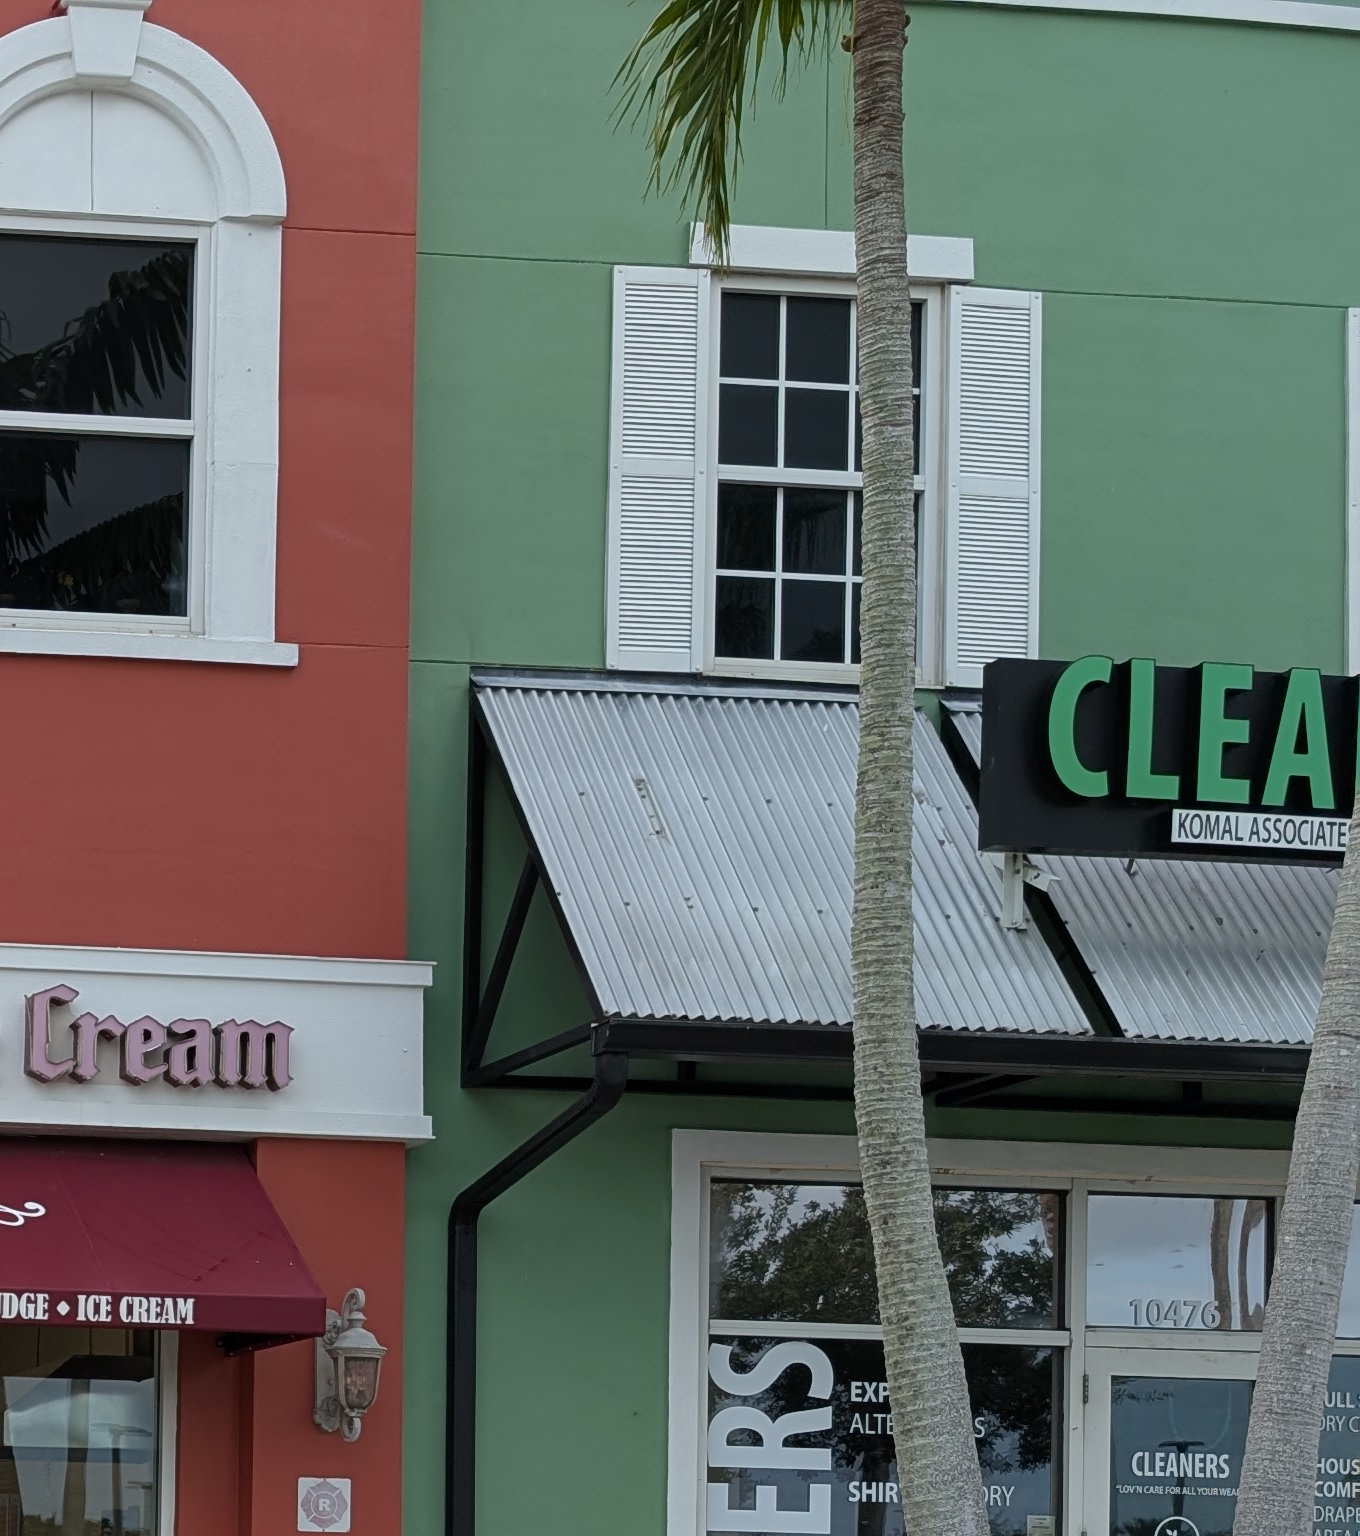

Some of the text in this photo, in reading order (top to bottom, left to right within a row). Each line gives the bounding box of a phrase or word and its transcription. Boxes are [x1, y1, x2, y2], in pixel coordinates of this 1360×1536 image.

[1048, 655, 1336, 809] CLEA
[1178, 812, 1348, 847] KOMAL ASSOCIATE
[24, 984, 296, 1092] Cream
[76, 1295, 112, 1323] ICE
[119, 1297, 195, 1325] CREAM
[1129, 1298, 1221, 1328] 10476
[850, 1381, 891, 1402] EXP
[1324, 1391, 1355, 1409] ULL
[1131, 1451, 1230, 1479] CLEANERS
[318, 1498, 330, 1511] R
[848, 1481, 901, 1503] SHIR
[1144, 1485, 1164, 1495] CARE
[1165, 1486, 1181, 1495] FOR
[1182, 1487, 1196, 1496] ALL
[1197, 1487, 1218, 1496] YOUR
